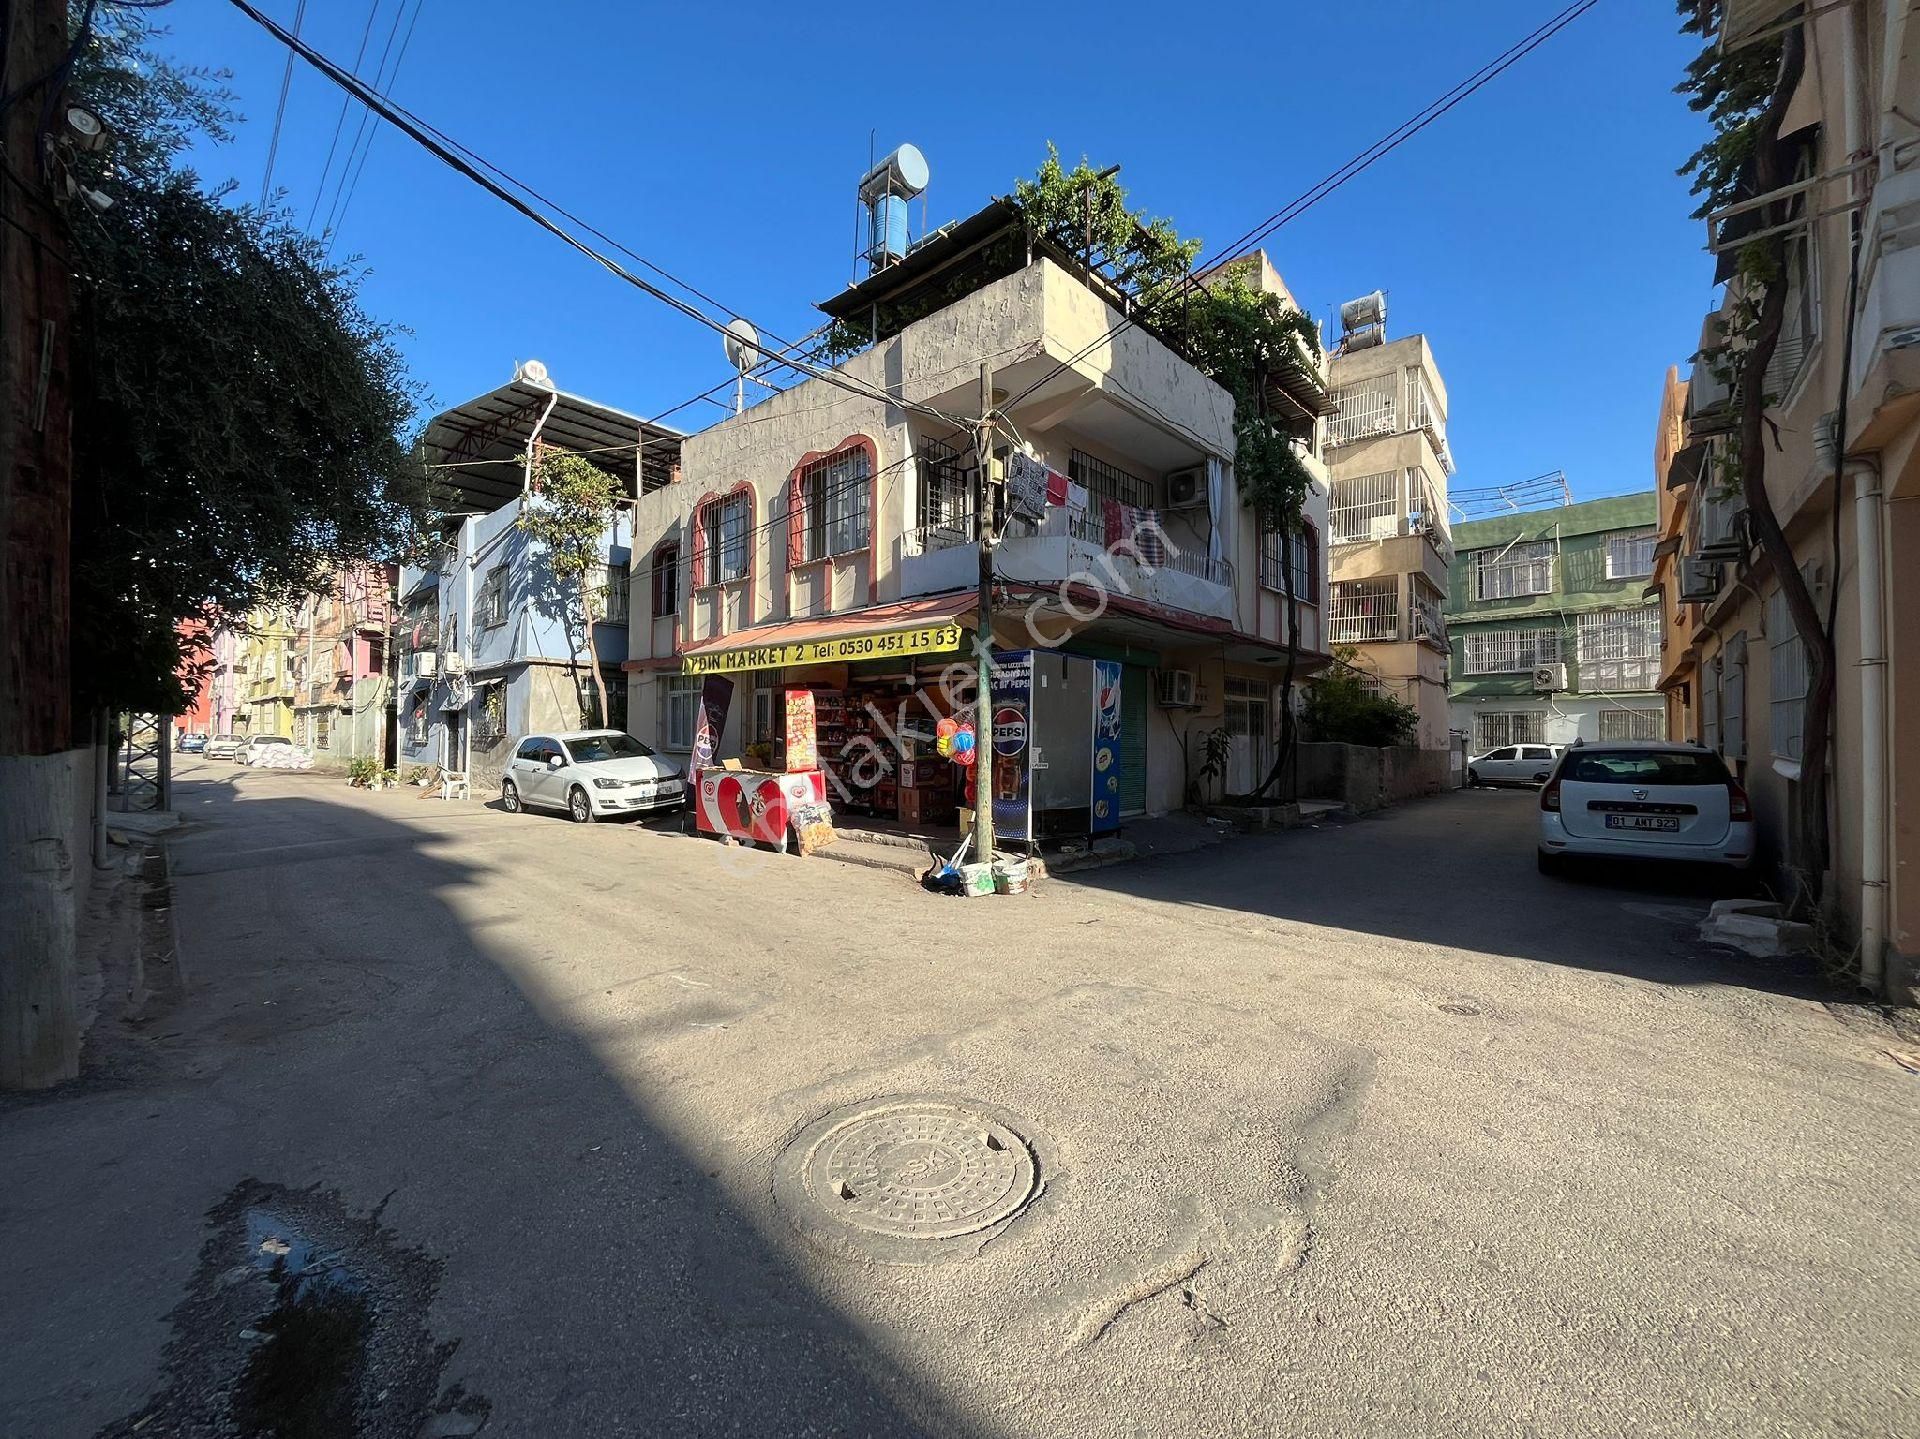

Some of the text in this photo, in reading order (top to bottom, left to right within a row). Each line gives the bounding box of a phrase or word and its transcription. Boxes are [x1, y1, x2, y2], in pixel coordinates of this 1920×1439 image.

[726, 647, 787, 668] MARKET
[795, 645, 804, 661] 2
[812, 643, 834, 658] Tel:
[839, 639, 873, 655] 0530
[877, 634, 904, 650] 451
[910, 631, 930, 647] 15
[935, 629, 958, 645] 63
[992, 727, 1025, 737] PEPSI
[1612, 816, 1625, 826] 01
[1656, 819, 1677, 829] 923
